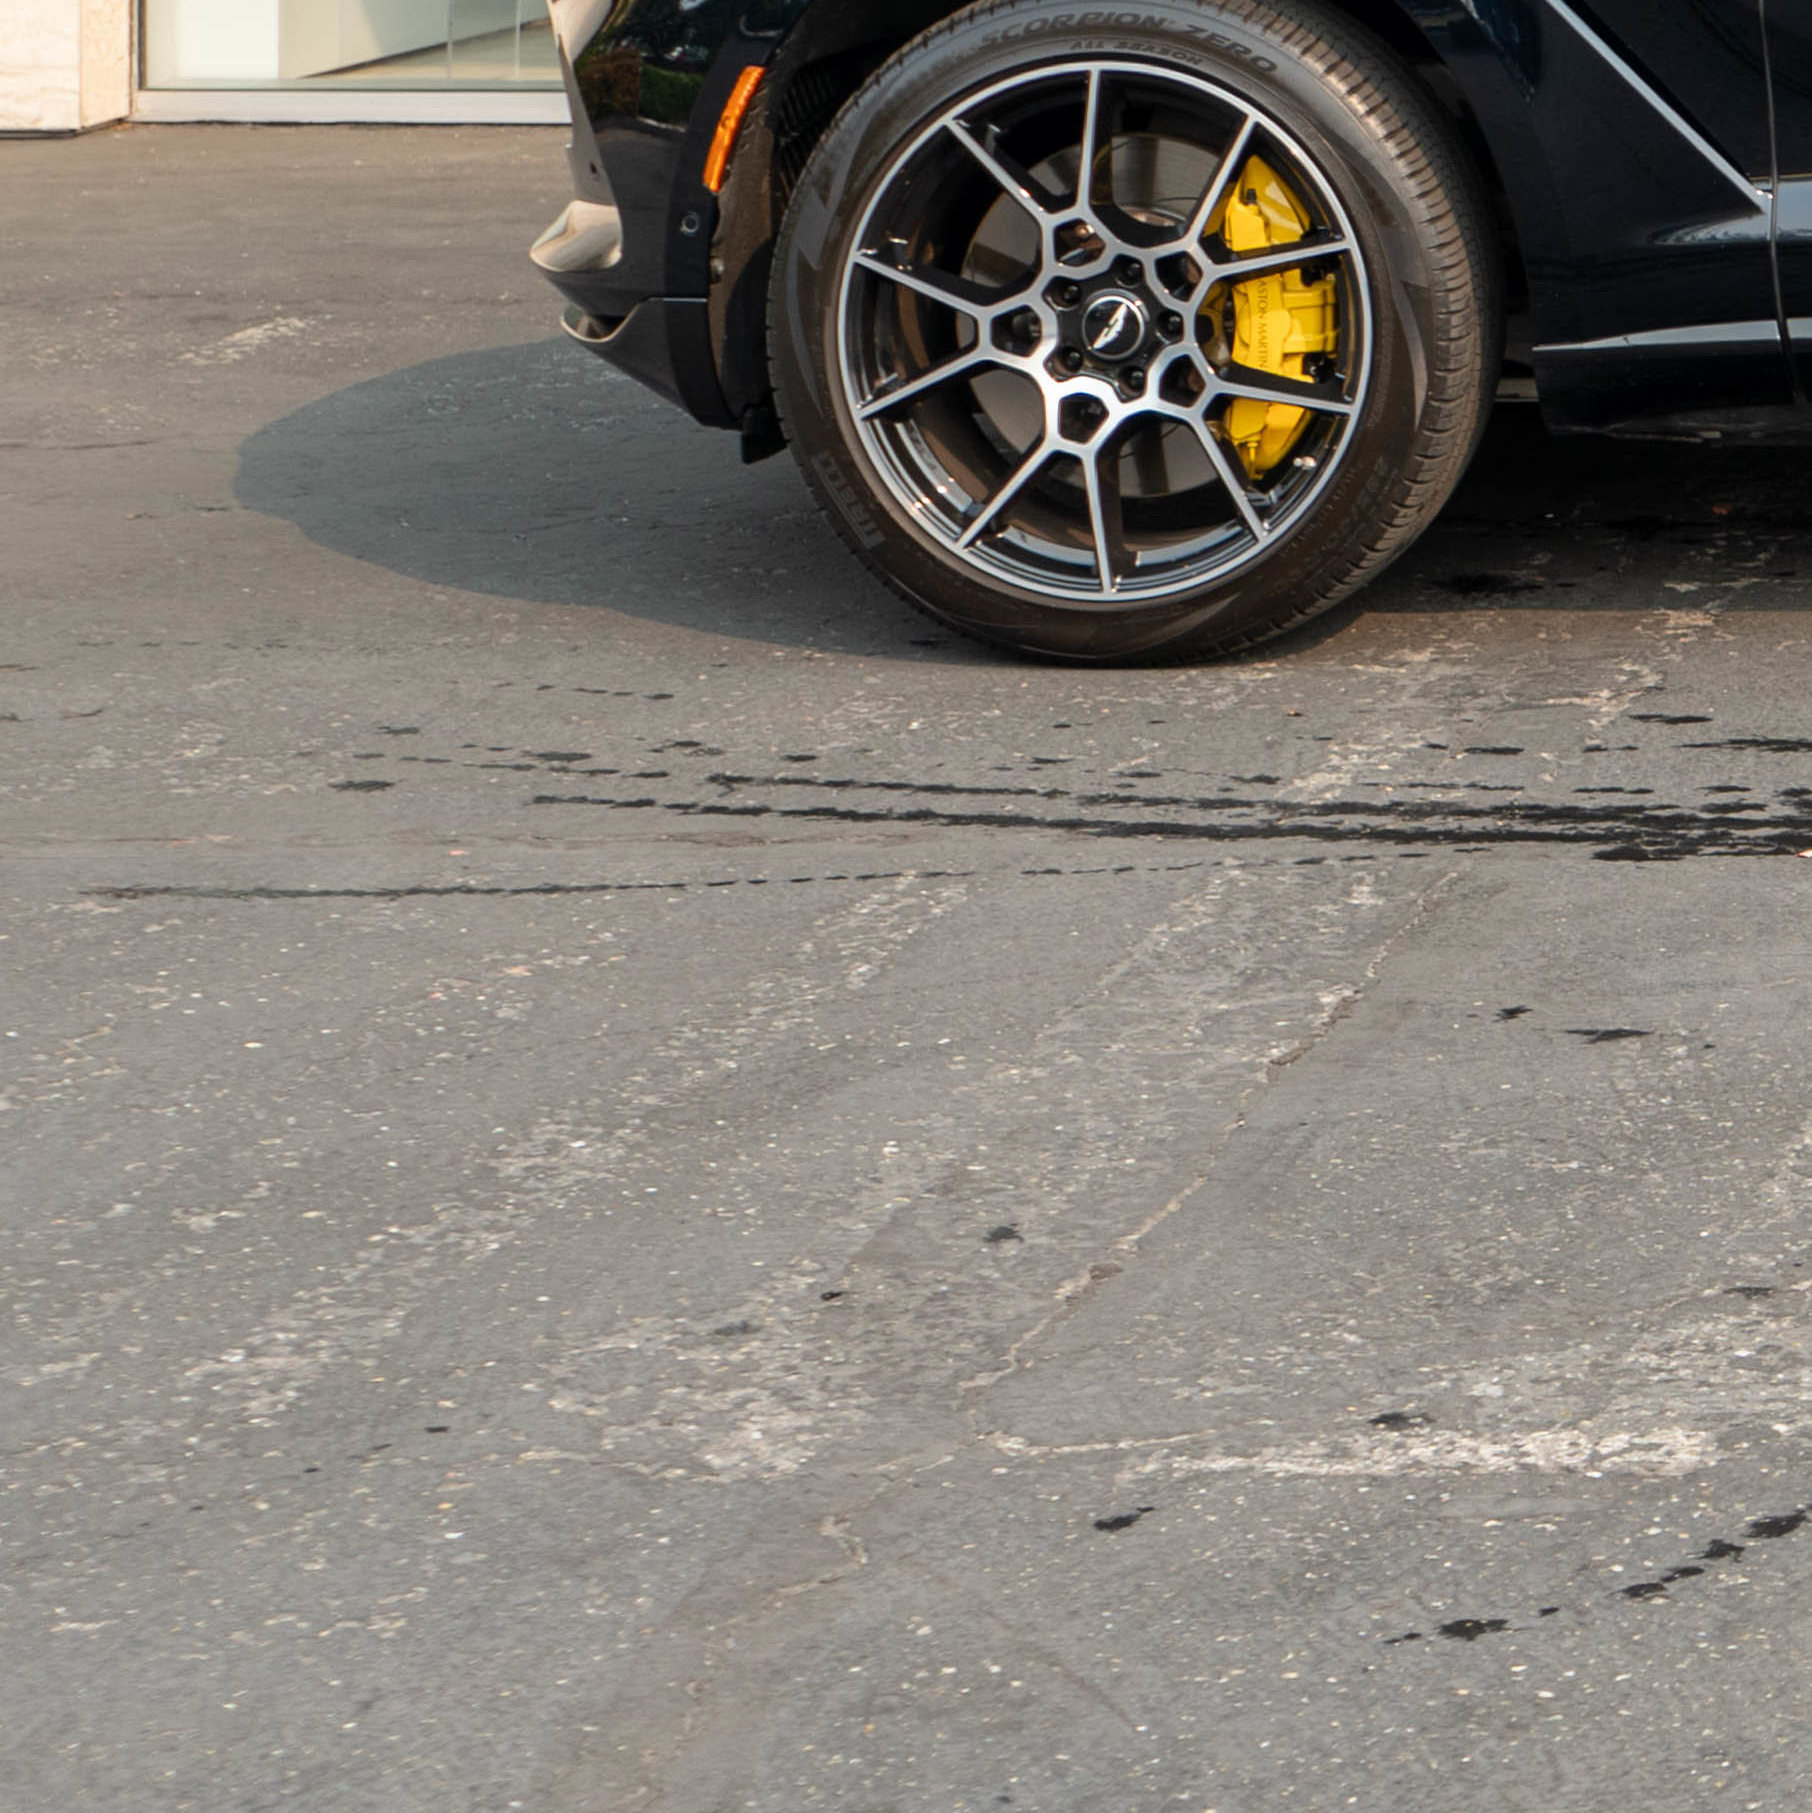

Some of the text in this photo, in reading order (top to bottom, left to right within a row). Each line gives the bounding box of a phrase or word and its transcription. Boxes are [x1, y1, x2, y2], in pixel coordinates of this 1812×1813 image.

[979, 11, 1278, 74] SCORPION ZERO
[1070, 39, 1206, 66] ALL SEASON
[1257, 279, 1269, 368] ASTON MARTIN
